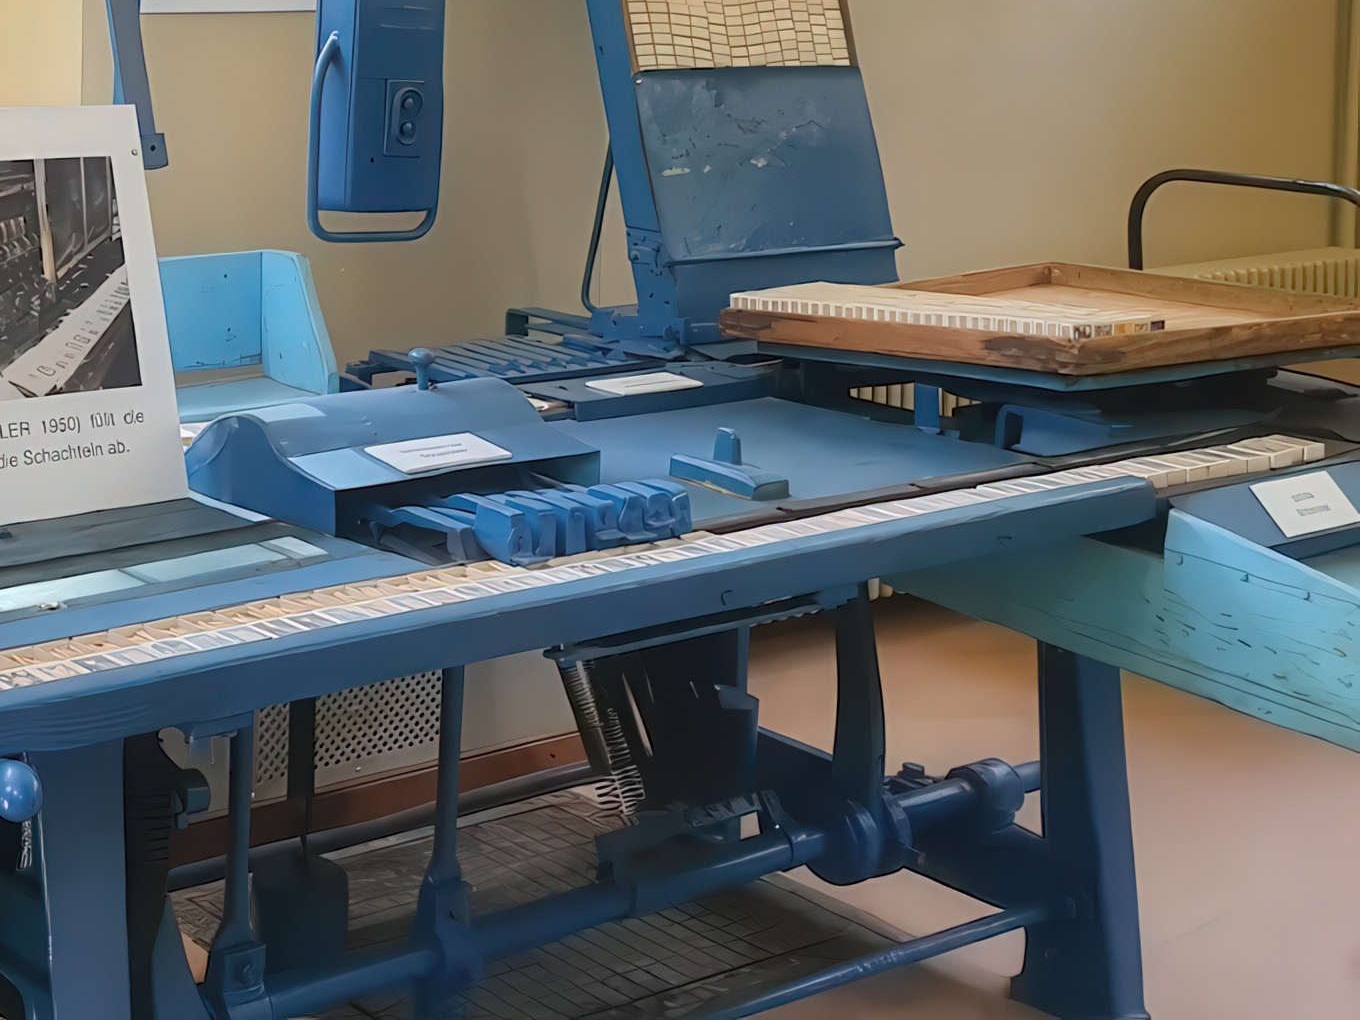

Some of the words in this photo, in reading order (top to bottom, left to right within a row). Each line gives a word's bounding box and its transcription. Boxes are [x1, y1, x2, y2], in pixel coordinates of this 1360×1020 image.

[41, 415, 81, 434] 1950)
[90, 411, 115, 429] füllt
[123, 409, 145, 425] die
[23, 441, 104, 466] Schachteln
[107, 439, 131, 455] ab.
